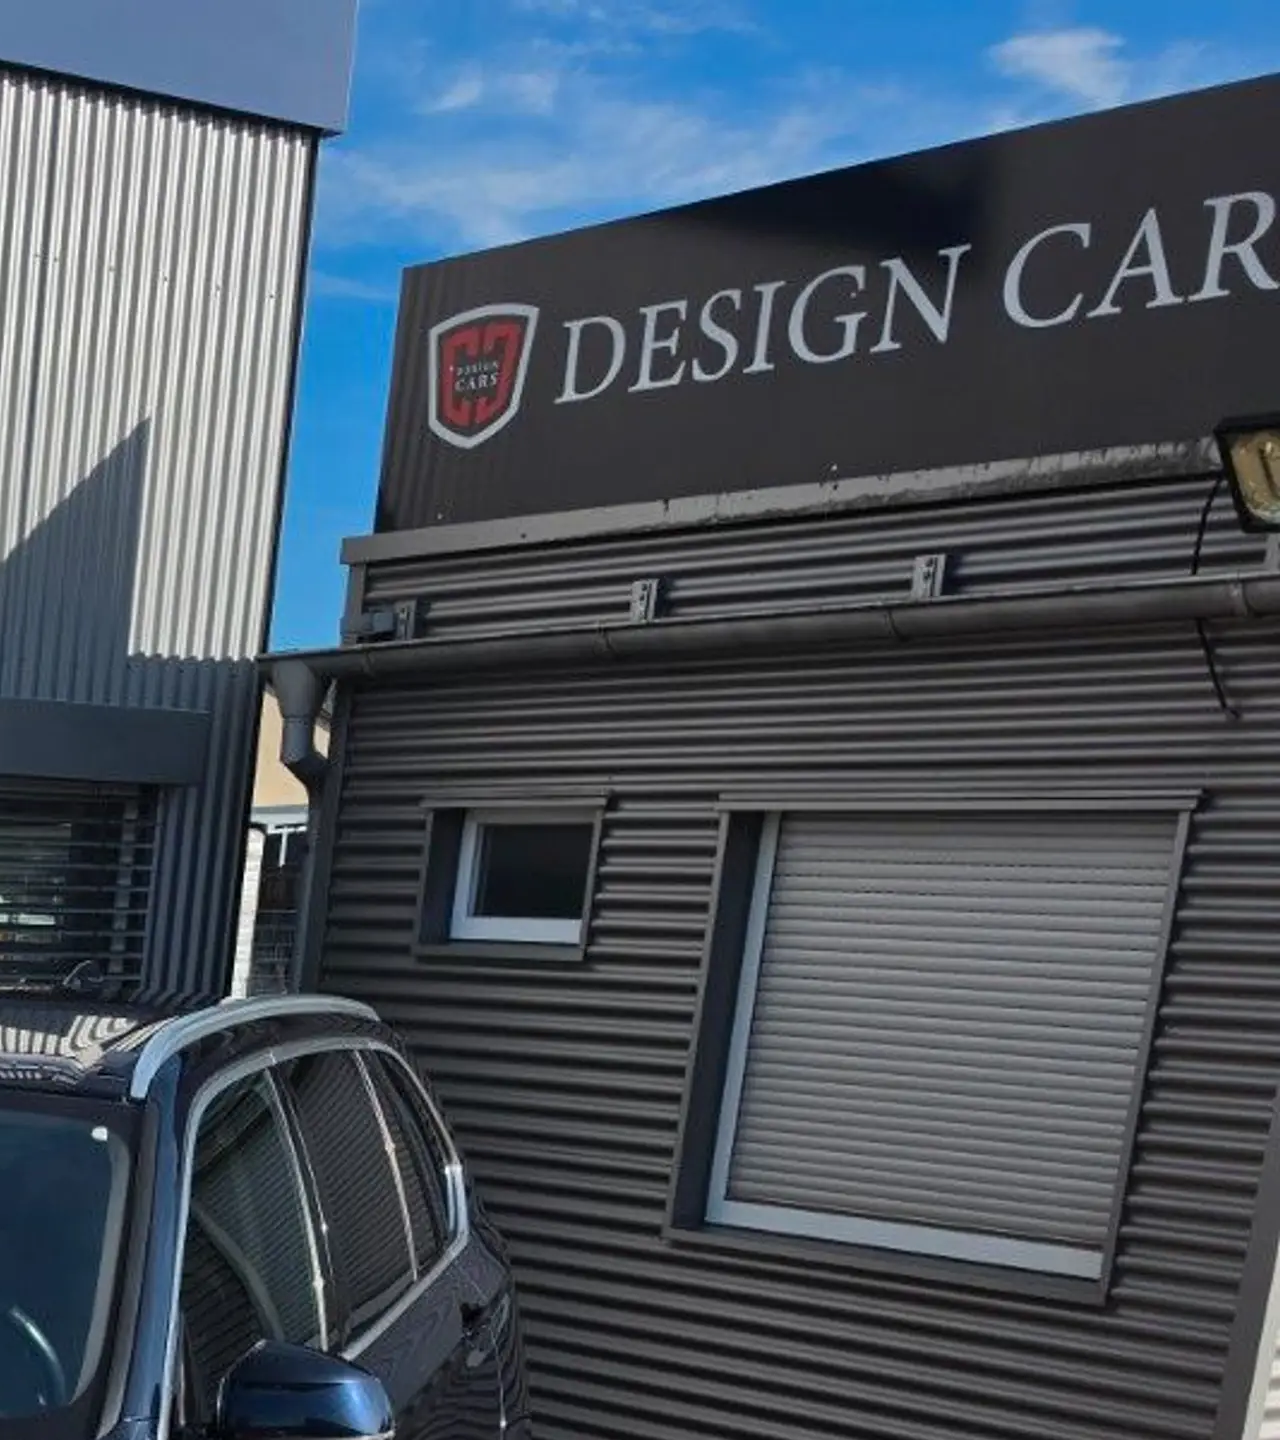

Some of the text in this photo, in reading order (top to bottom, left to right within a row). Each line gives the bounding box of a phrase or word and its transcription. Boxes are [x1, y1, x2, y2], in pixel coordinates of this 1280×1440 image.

[553, 190, 1280, 405] DESIGN CAR
[453, 371, 500, 392] CARS
